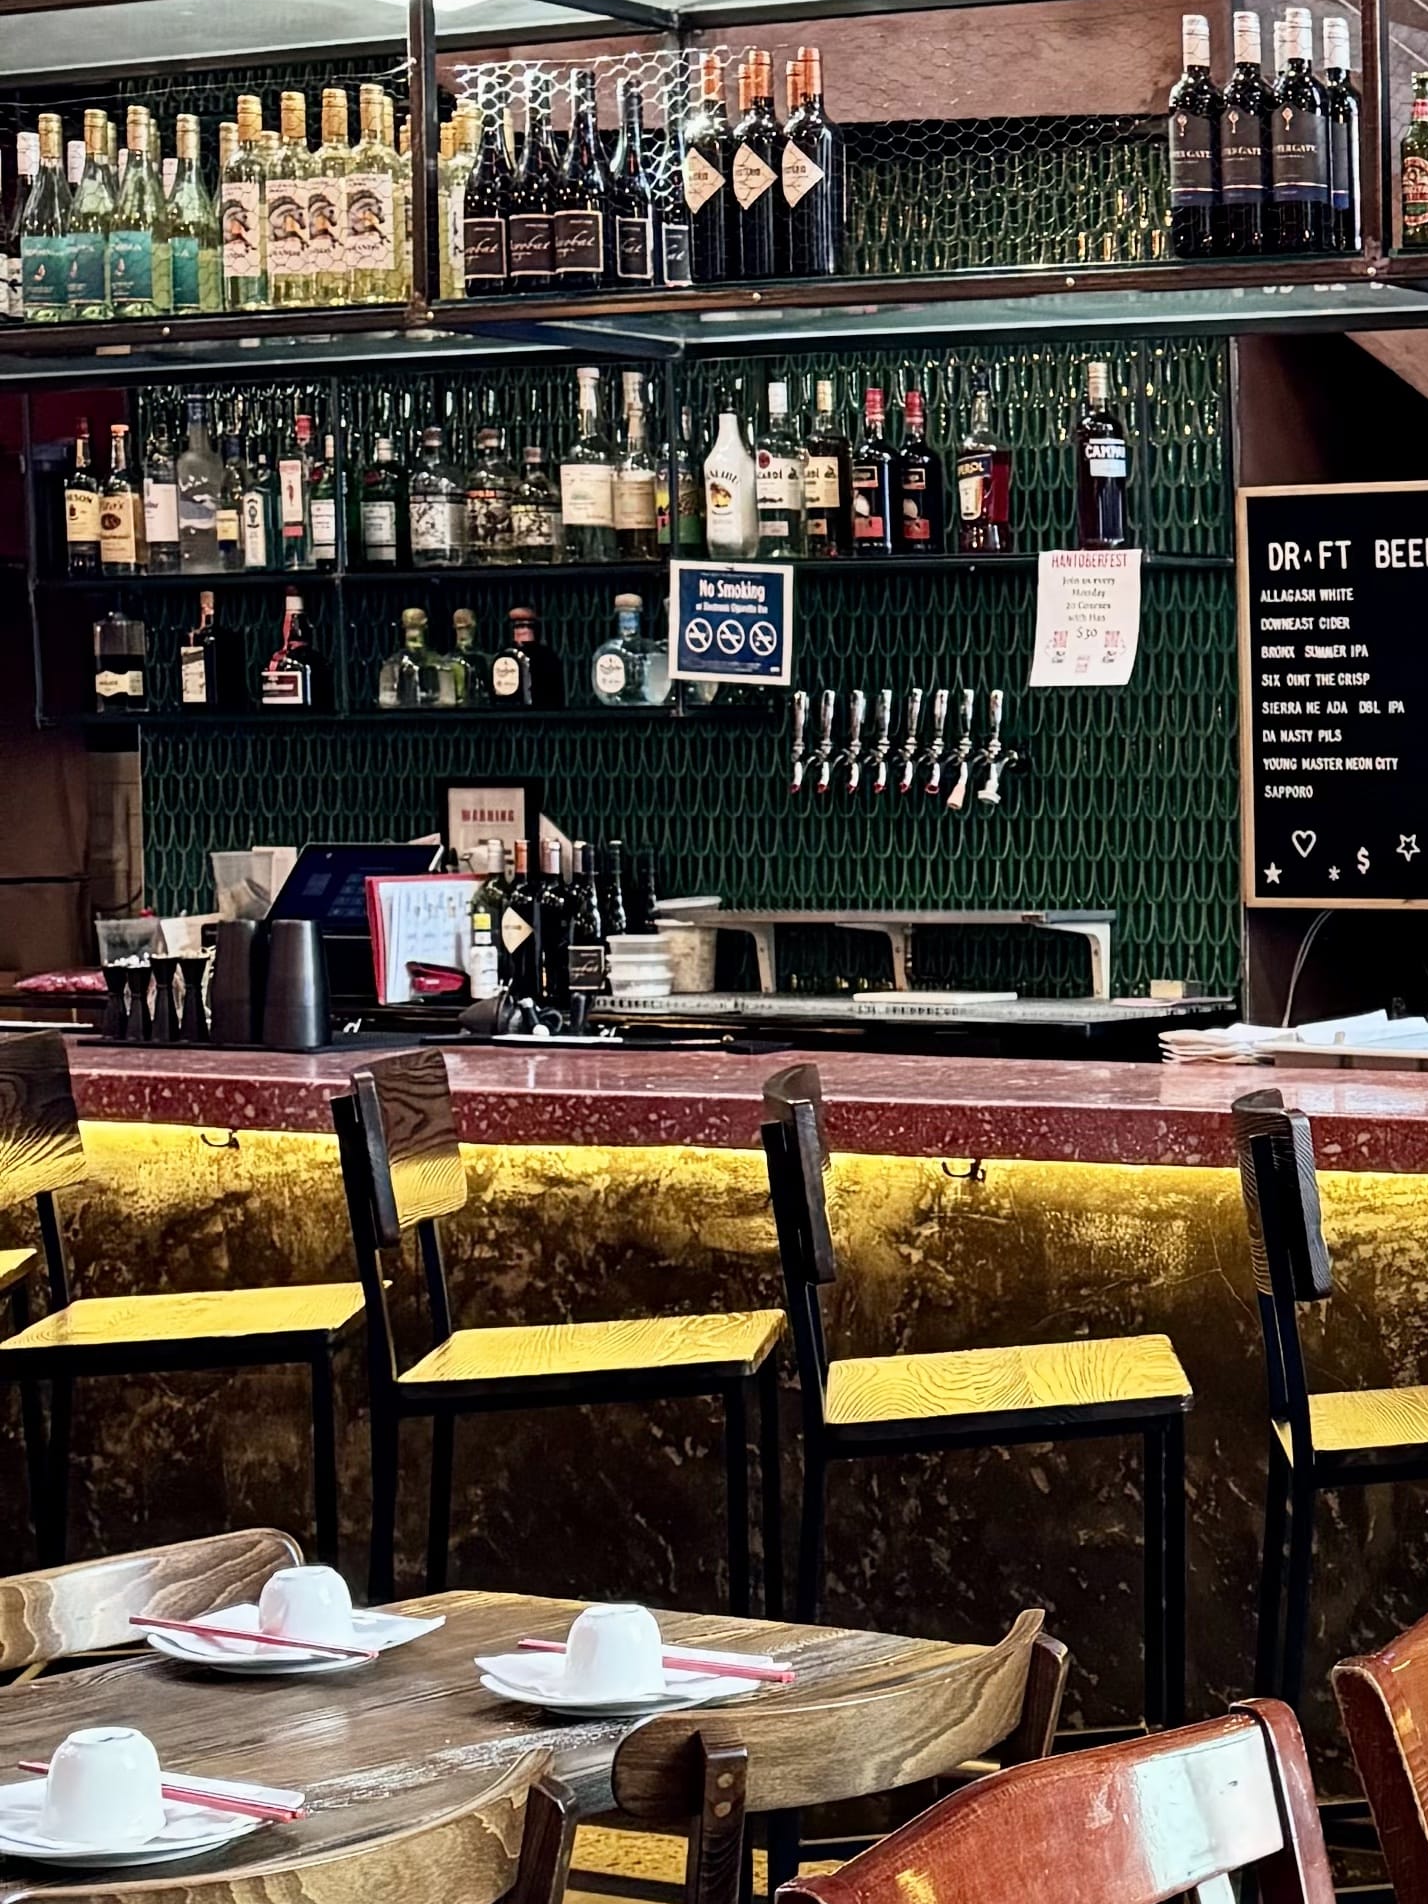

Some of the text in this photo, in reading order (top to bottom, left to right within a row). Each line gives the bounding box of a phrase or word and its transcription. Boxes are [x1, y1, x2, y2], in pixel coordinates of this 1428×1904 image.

[698, 579, 765, 603] No Smoking
[1260, 588, 1317, 603] ALLAGASH
[1319, 587, 1355, 602] WHITE
[1260, 616, 1315, 631] DOWNEAST
[1318, 616, 1351, 630] CIDER
[1260, 645, 1296, 659] BRONX
[1305, 645, 1347, 659] SUMMER
[1350, 644, 1369, 658] IPA
[1261, 673, 1281, 688] SIX
[1315, 673, 1336, 687] THE
[1337, 672, 1371, 686] CRISP
[1261, 700, 1303, 715] SIERRA
[1358, 700, 1382, 715] DBL
[1388, 700, 1406, 715] IPA
[1262, 729, 1277, 743] DA
[1280, 729, 1314, 743] NASTY
[1318, 728, 1343, 743] PILS
[1263, 757, 1298, 771] YOUNG
[1302, 757, 1344, 771] MASTER
[1345, 757, 1374, 771] NEON
[1375, 757, 1399, 771] CITY
[1264, 785, 1314, 799] SAPPORO
